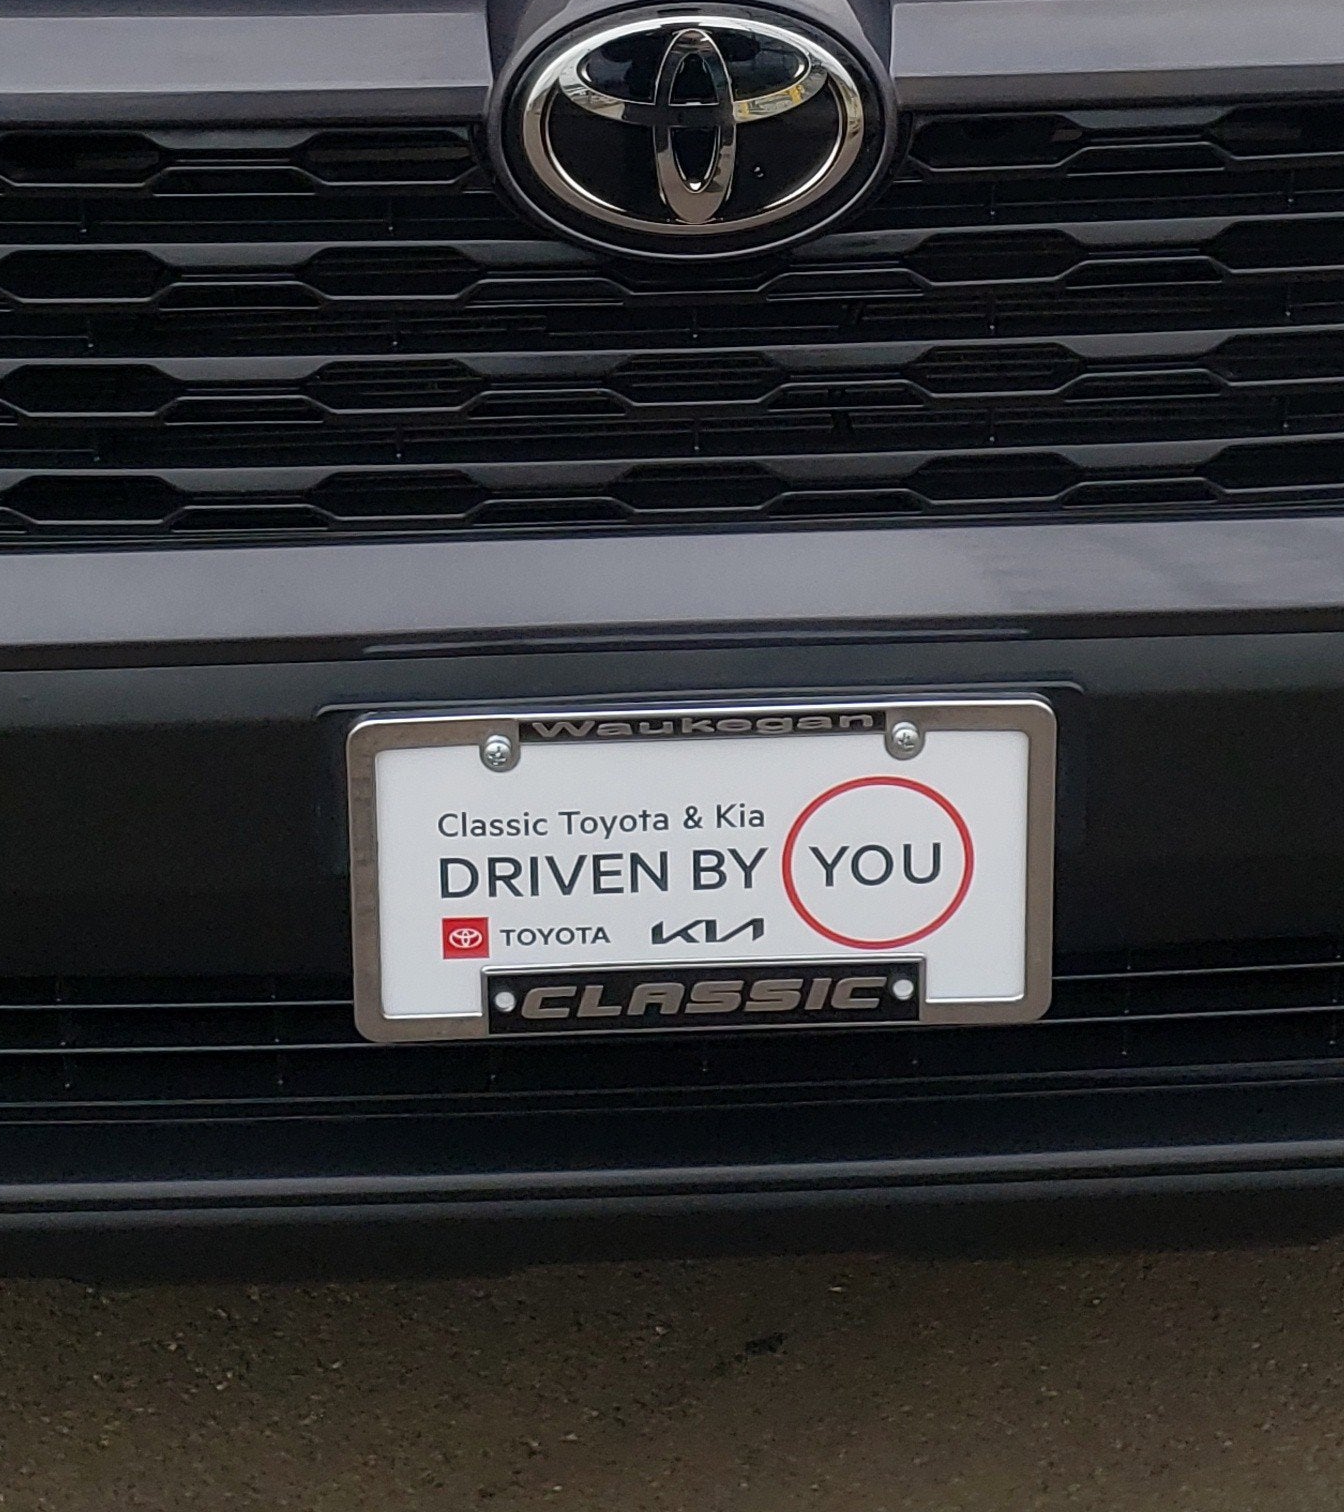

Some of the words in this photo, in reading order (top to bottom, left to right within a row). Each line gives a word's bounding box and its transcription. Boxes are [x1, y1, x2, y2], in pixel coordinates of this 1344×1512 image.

[531, 713, 874, 737] Waukegan
[437, 811, 549, 838] Classic
[558, 808, 670, 839] Toyota
[682, 805, 704, 830] &
[715, 803, 766, 829] Kia
[439, 850, 669, 899] DRIVEN
[692, 846, 769, 891] BY
[808, 842, 942, 887] YOU
[500, 926, 612, 947] TOYOTA
[520, 976, 888, 1020] CLASSIC
